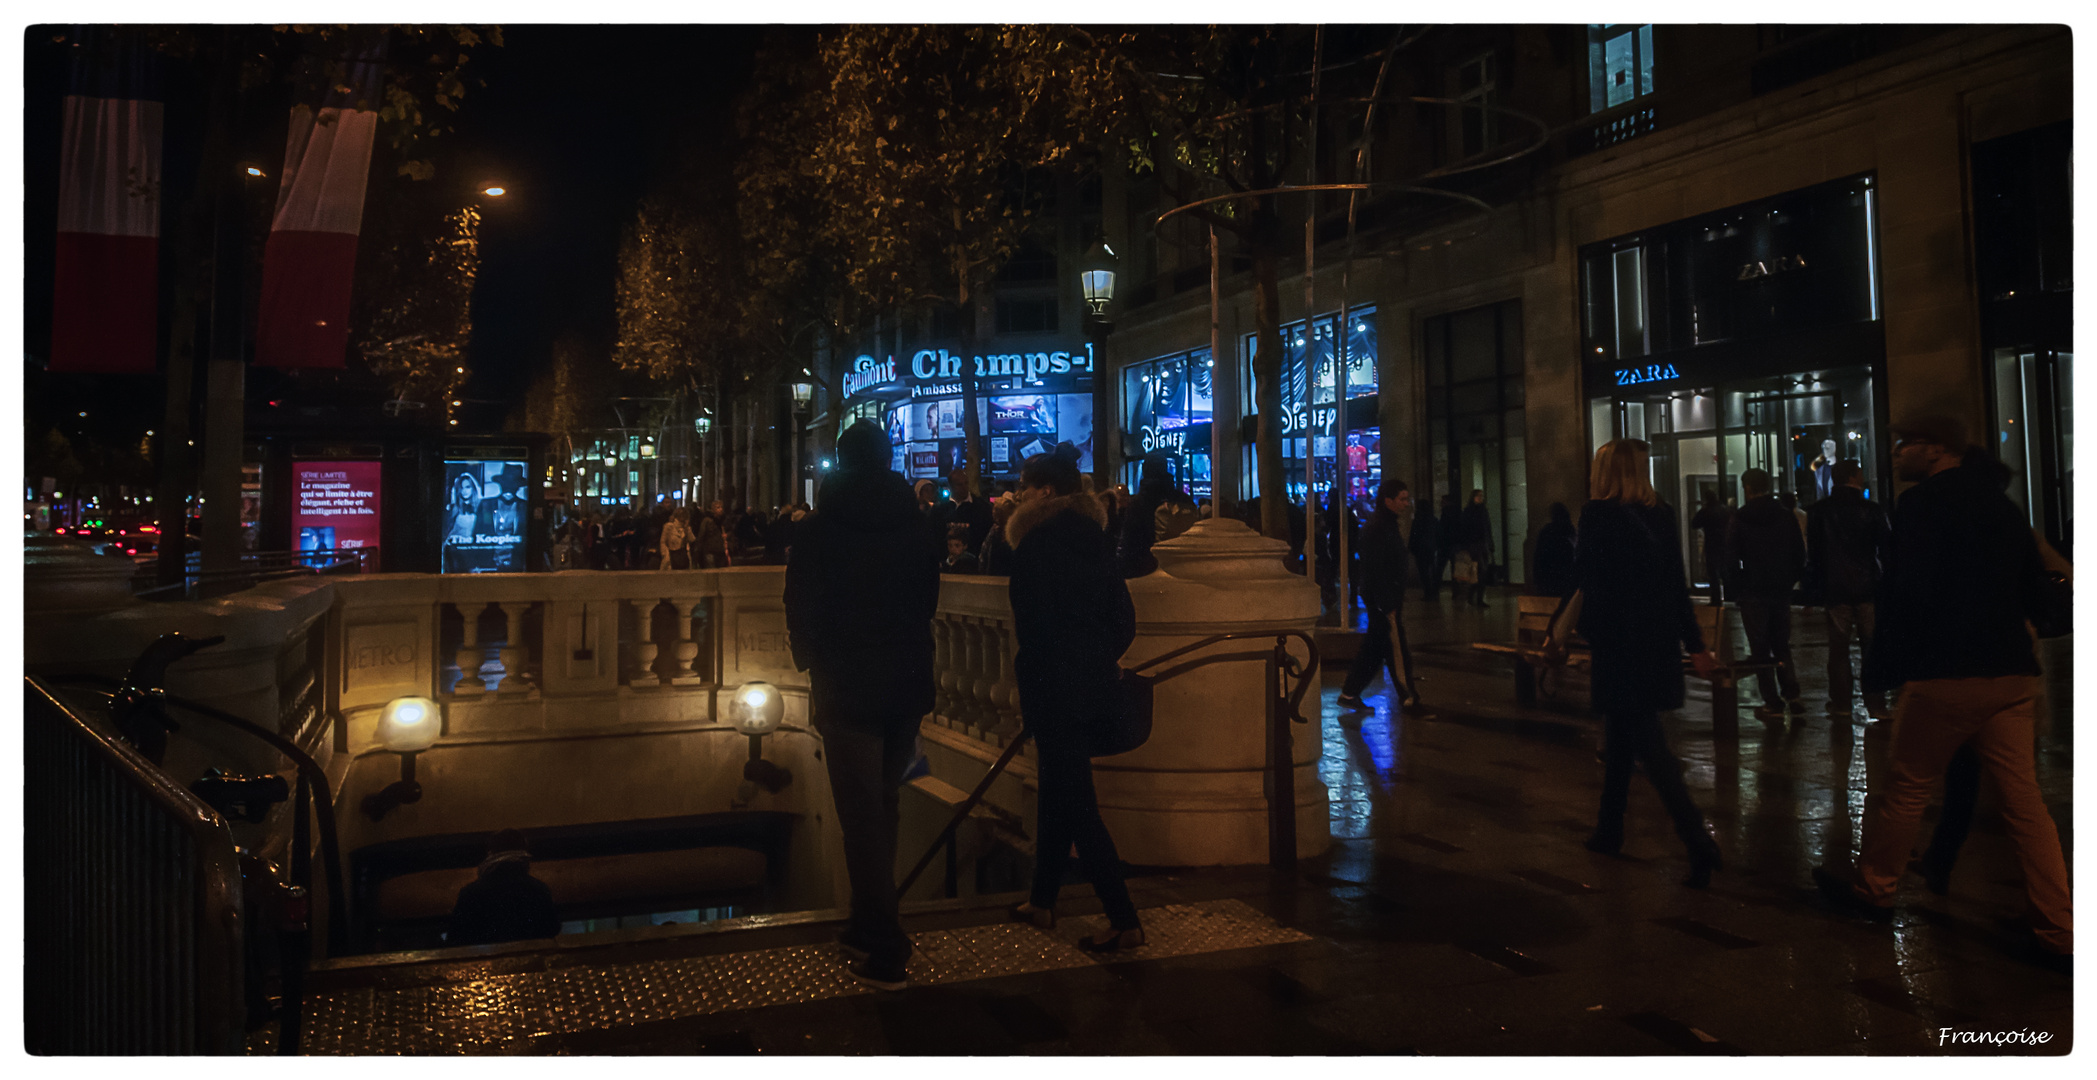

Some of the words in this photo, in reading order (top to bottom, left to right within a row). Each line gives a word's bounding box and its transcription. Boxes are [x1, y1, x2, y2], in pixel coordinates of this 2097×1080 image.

[1737, 254, 1807, 280] ZARA
[842, 354, 897, 399] Gaumont
[1614, 363, 1680, 386] ZARA
[995, 409, 1025, 419] THOR
[301, 481, 311, 489] Le
[312, 482, 351, 491] magazine
[300, 491, 314, 499] qui
[325, 490, 349, 498] limite
[356, 490, 373, 498] être
[300, 507, 342, 516] intelligent
[349, 507, 357, 515] la
[451, 535, 473, 544] The
[475, 534, 521, 545] Kooples
